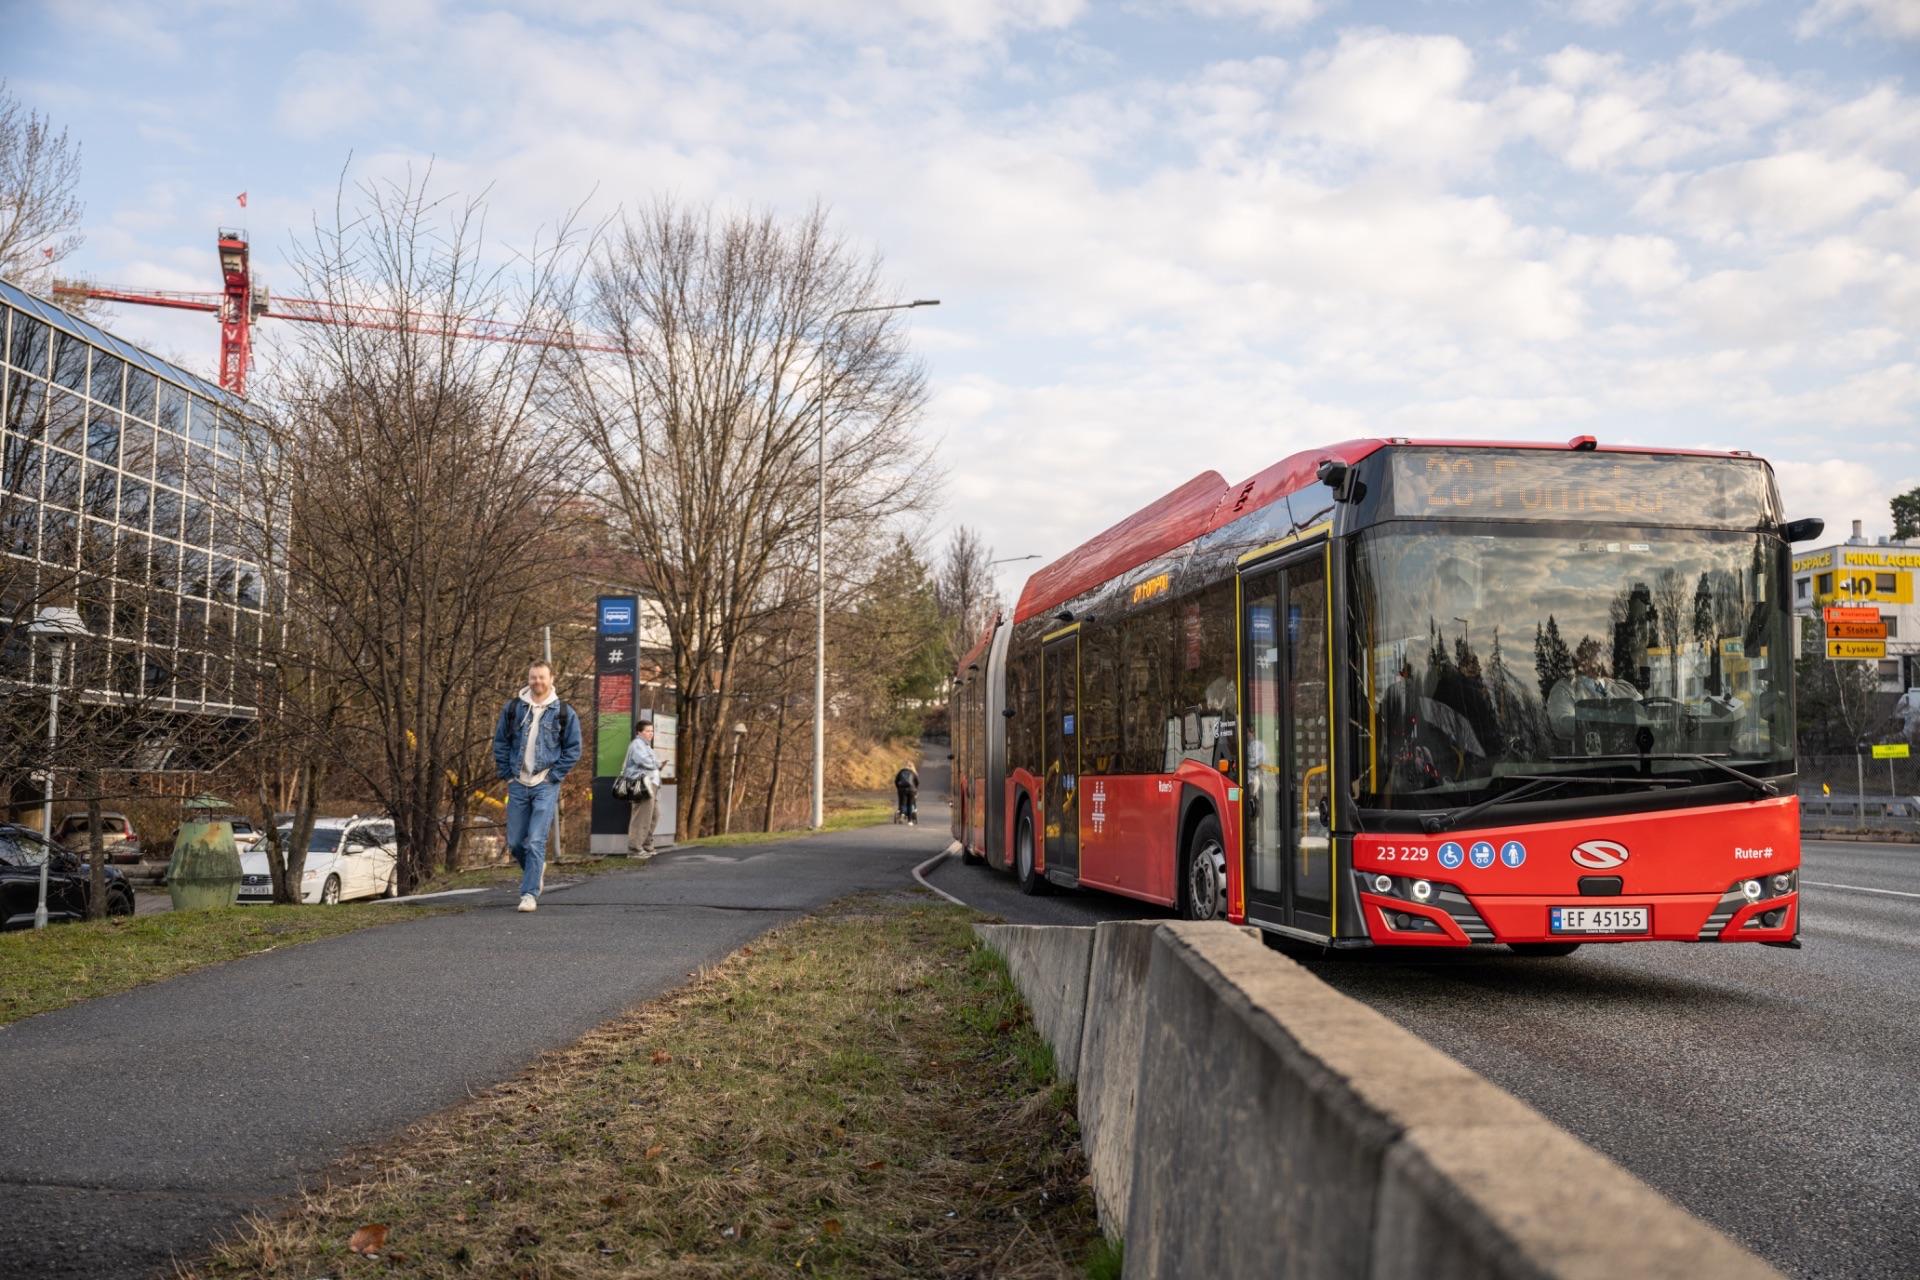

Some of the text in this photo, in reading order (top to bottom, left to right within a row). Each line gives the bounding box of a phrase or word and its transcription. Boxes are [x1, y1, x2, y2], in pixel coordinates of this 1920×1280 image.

[1801, 552, 1832, 570] SPACE
[1846, 626, 1879, 635] Stabekk
[1846, 644, 1879, 655] Lysaker
[1377, 846, 1429, 861] 23 229
[1734, 847, 1773, 859] Ruter#
[1567, 911, 1641, 927] EF 45155
